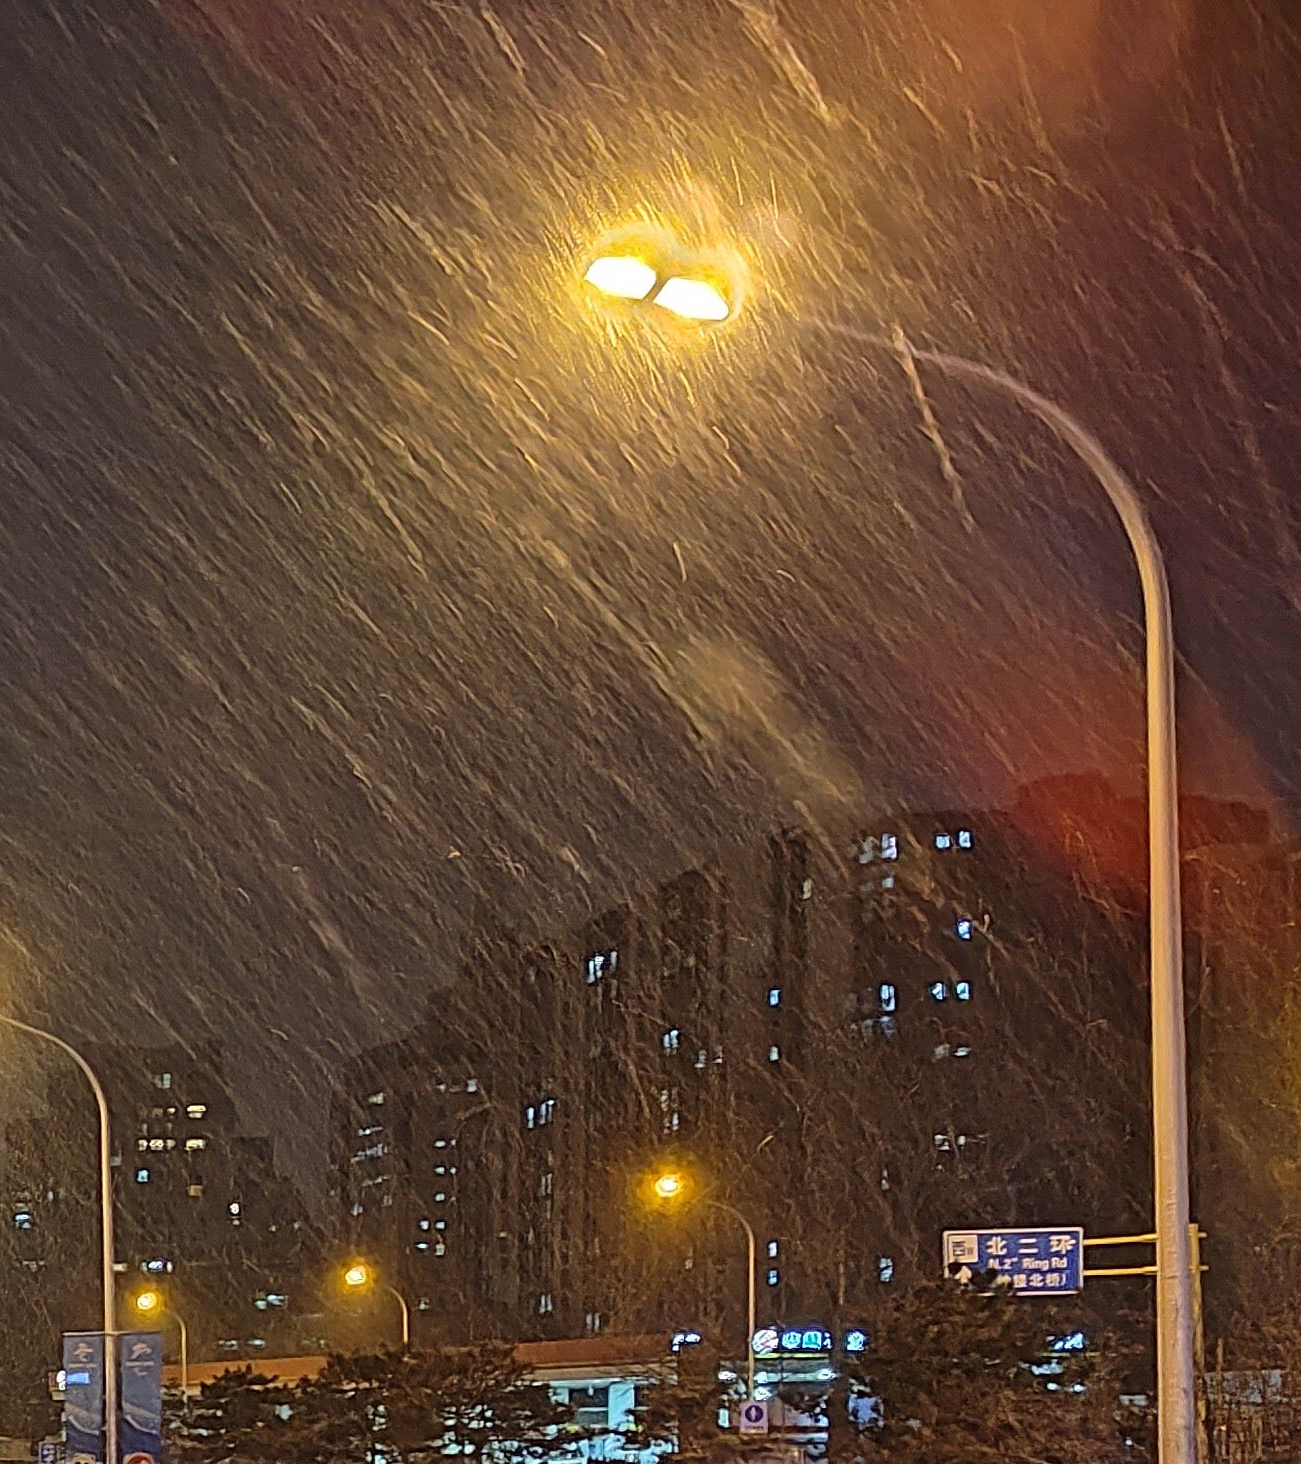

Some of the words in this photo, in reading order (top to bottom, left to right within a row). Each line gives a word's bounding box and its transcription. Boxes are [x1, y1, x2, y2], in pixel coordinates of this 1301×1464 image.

[985, 1235, 1077, 1255] 北二环
[1022, 1258, 1049, 1271] Ring
[1051, 1256, 1068, 1269] Rd
